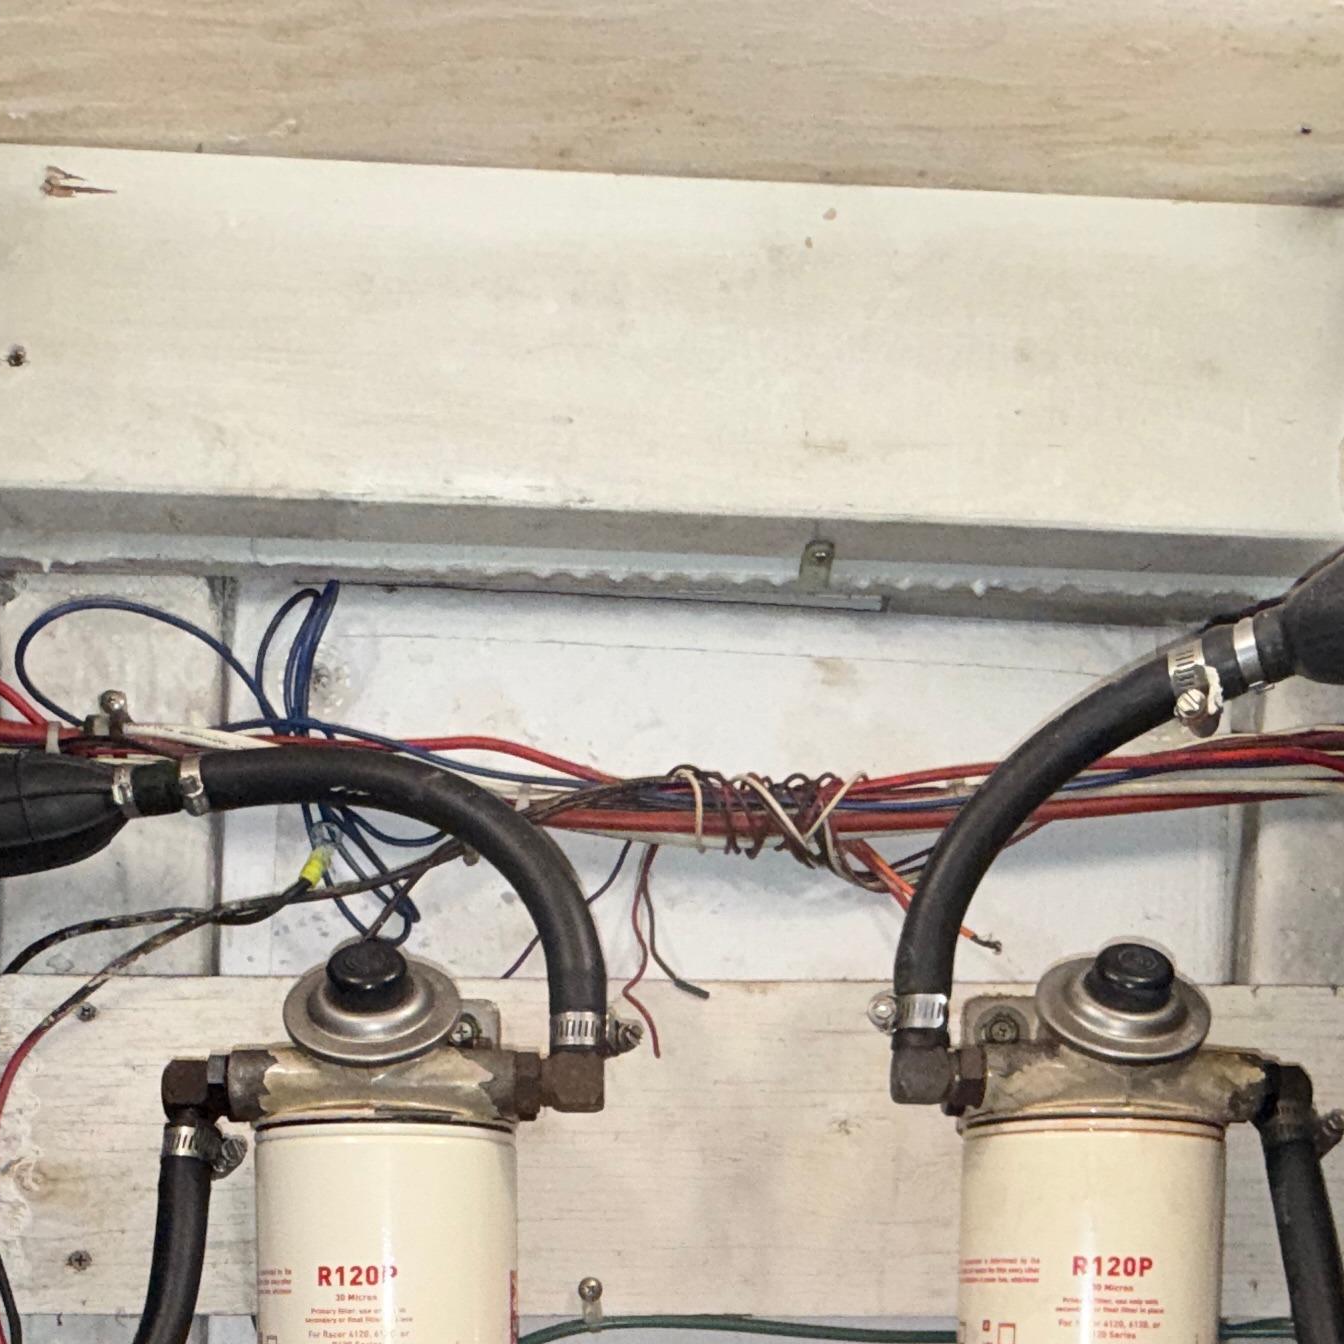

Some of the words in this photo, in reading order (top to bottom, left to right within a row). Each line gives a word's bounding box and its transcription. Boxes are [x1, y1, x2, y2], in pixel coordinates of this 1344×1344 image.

[1072, 1256, 1153, 1277] R120P
[318, 1266, 397, 1286] R120P
[1104, 1284, 1134, 1292] Micron
[1109, 1331, 1136, 1339] Series
